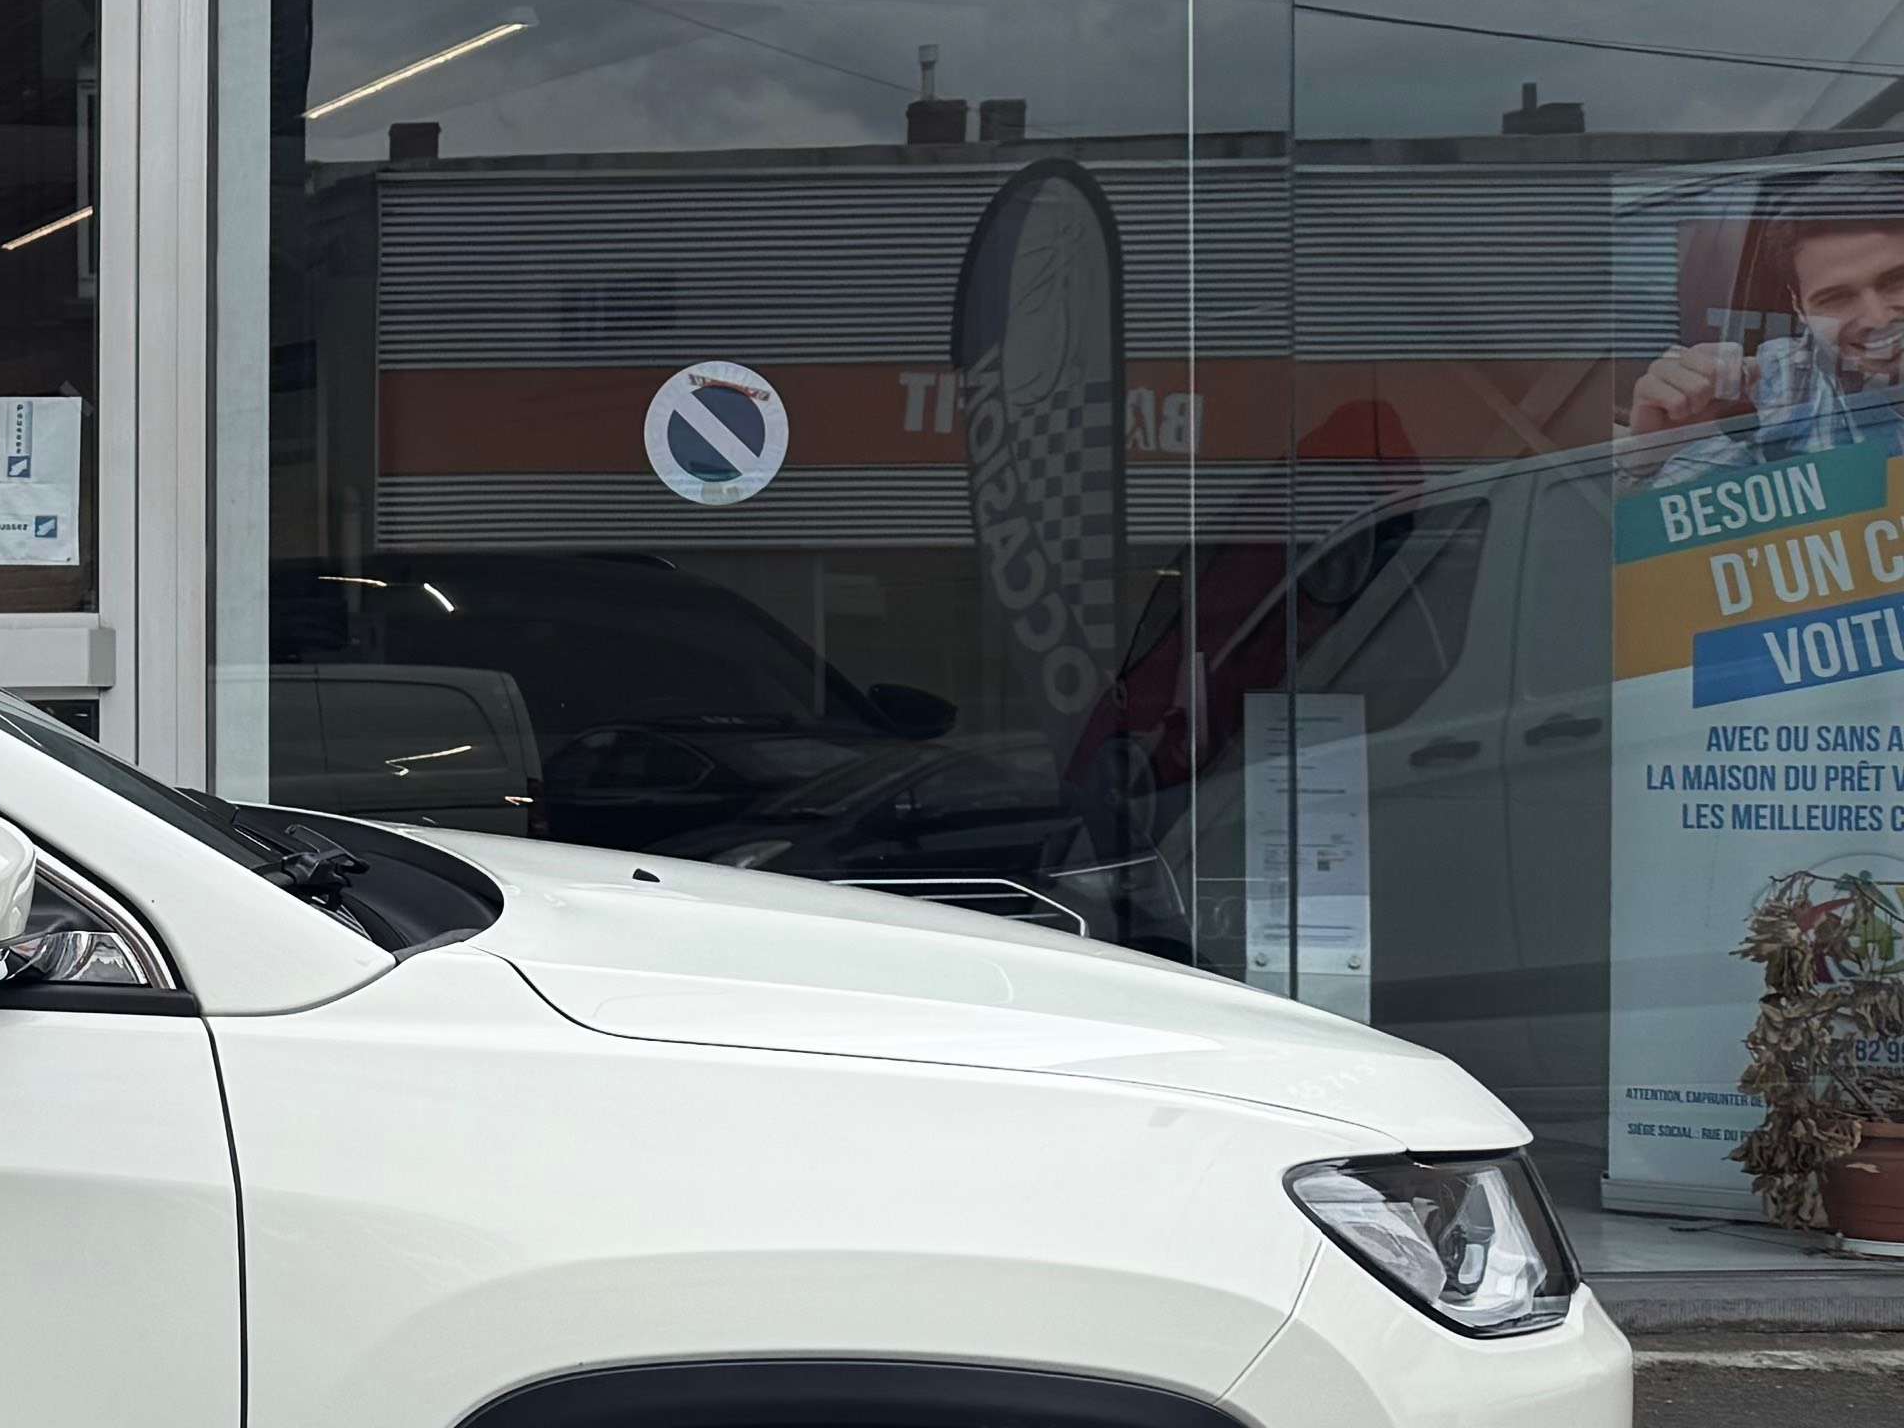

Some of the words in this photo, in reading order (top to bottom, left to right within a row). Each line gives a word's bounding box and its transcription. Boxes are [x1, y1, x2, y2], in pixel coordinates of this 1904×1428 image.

[1659, 463, 1827, 543] BESOIN
[1709, 529, 1855, 616] D'UN
[1706, 725, 1769, 753] AVEC
[1776, 725, 1809, 753] OU
[1816, 725, 1881, 753] SANS
[1646, 764, 1675, 791] LA
[1682, 764, 1776, 791] MAISON
[1784, 764, 1817, 792] DU
[1824, 759, 1886, 792] PRÊT
[1681, 803, 1725, 830] LES
[1731, 803, 1884, 832] MEILLEURES
